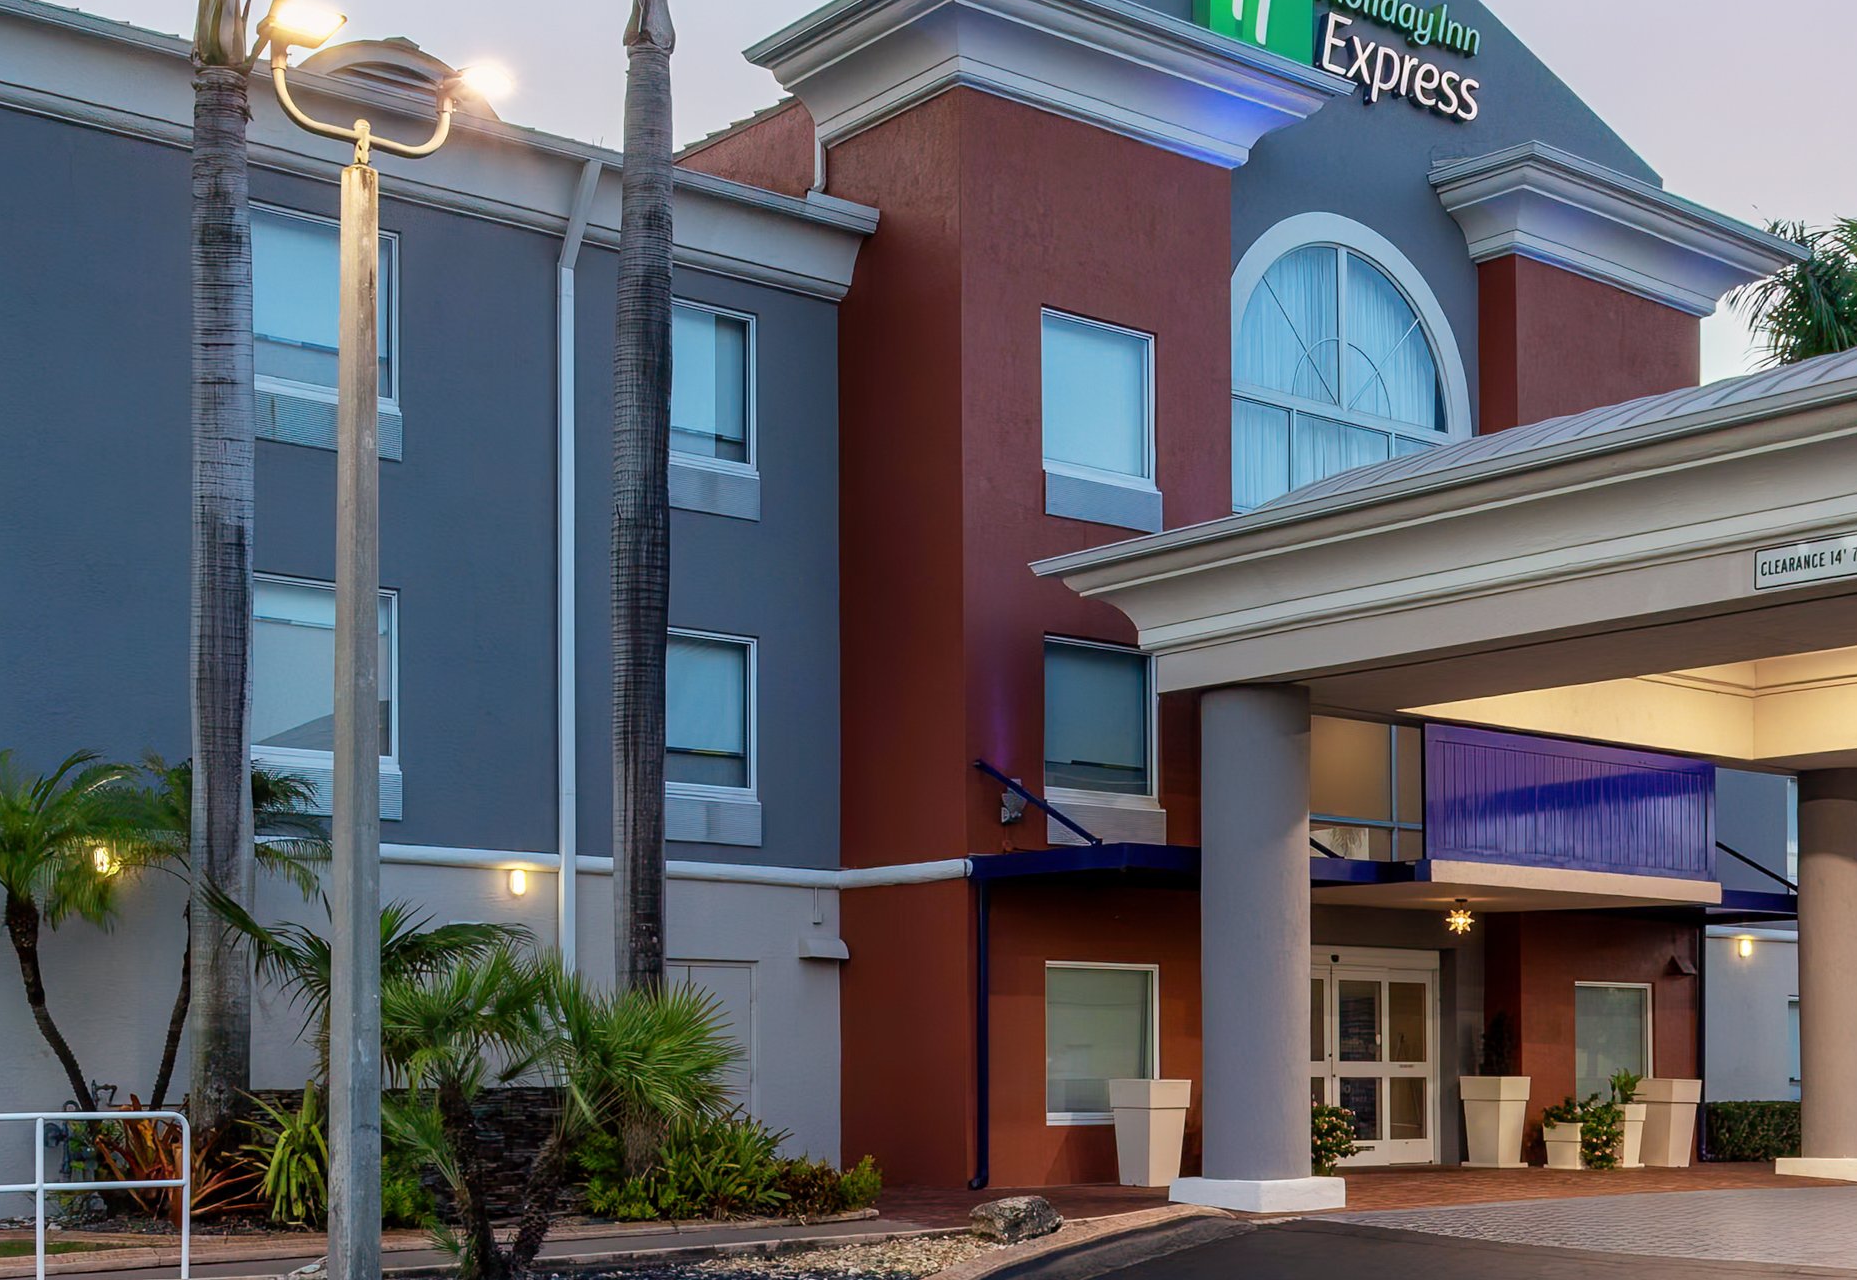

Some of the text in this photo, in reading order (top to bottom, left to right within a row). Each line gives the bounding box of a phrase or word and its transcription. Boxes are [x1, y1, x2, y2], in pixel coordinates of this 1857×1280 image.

[1438, 4, 1480, 55] Inn
[1322, 12, 1480, 121] Express
[1760, 552, 1826, 576] CLEARANCE
